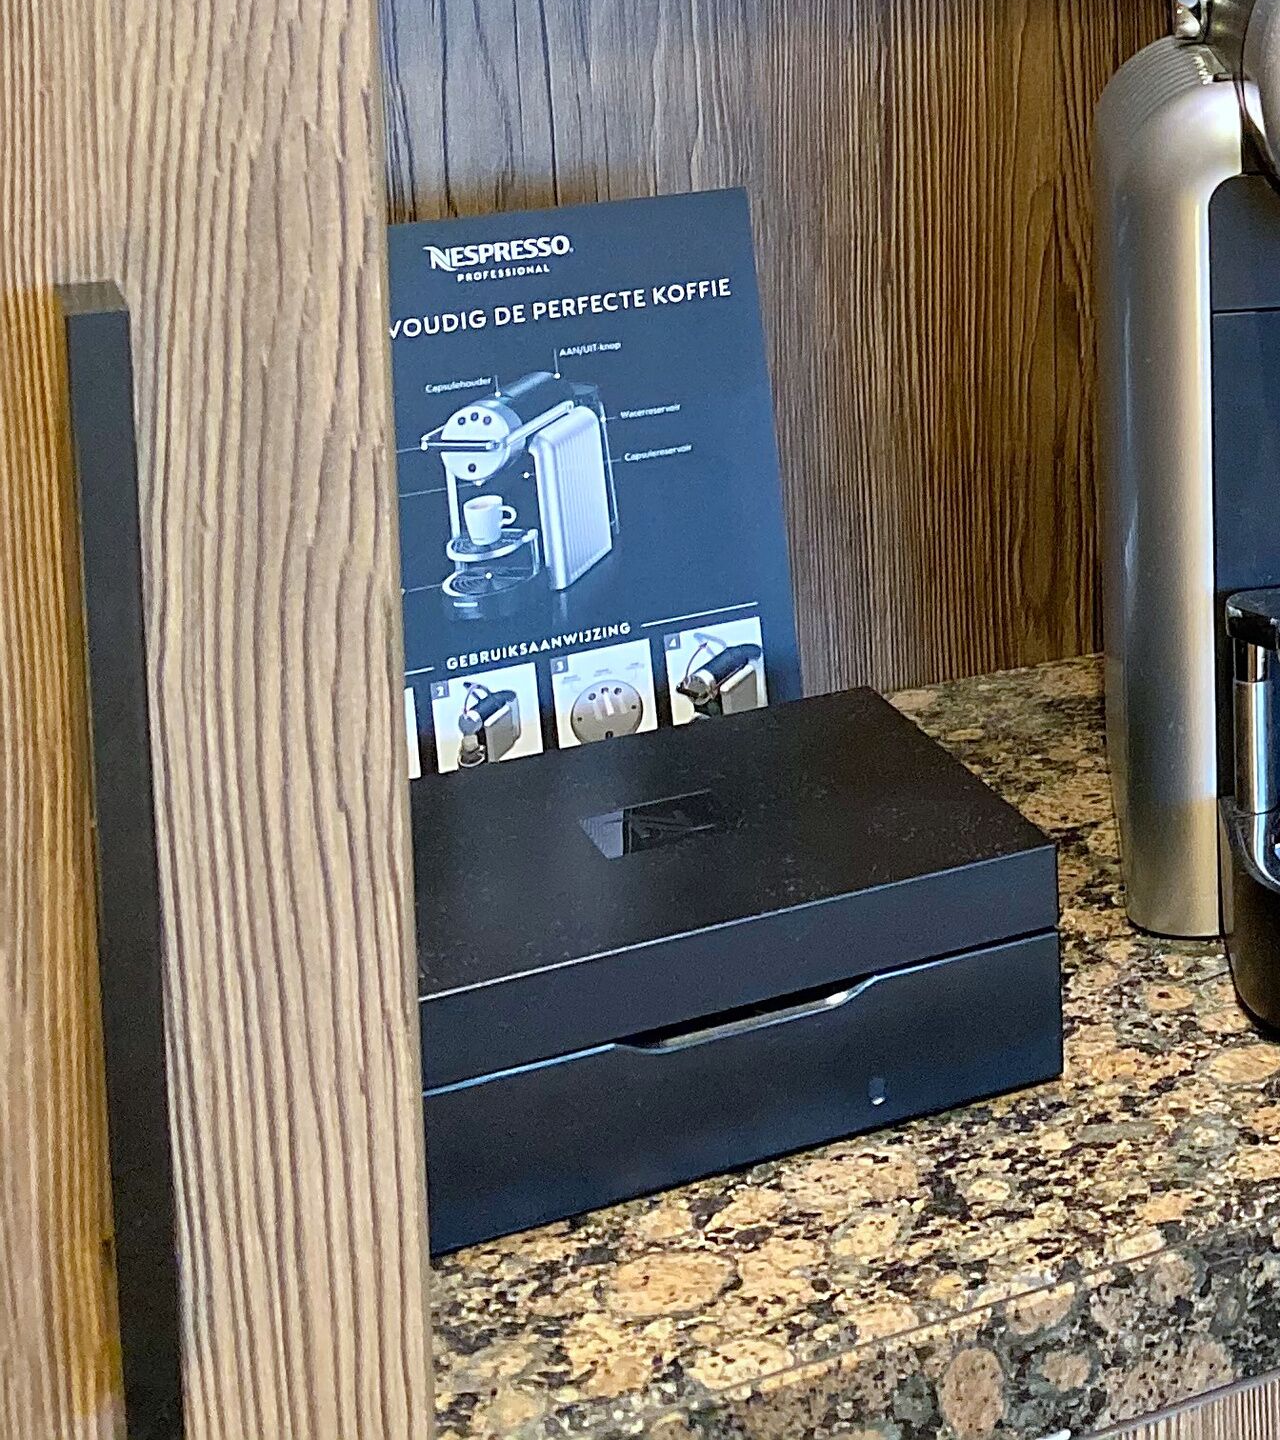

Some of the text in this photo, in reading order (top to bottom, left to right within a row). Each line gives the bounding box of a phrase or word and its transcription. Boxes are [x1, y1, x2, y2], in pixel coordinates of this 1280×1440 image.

[422, 234, 572, 272] NESPRESSO
[456, 263, 551, 283] PROFESSIONAL
[389, 277, 732, 340] VOUDIG DE PERFECTE KOFFIE
[445, 622, 632, 670] GEBRUIKSAANWIJZING
